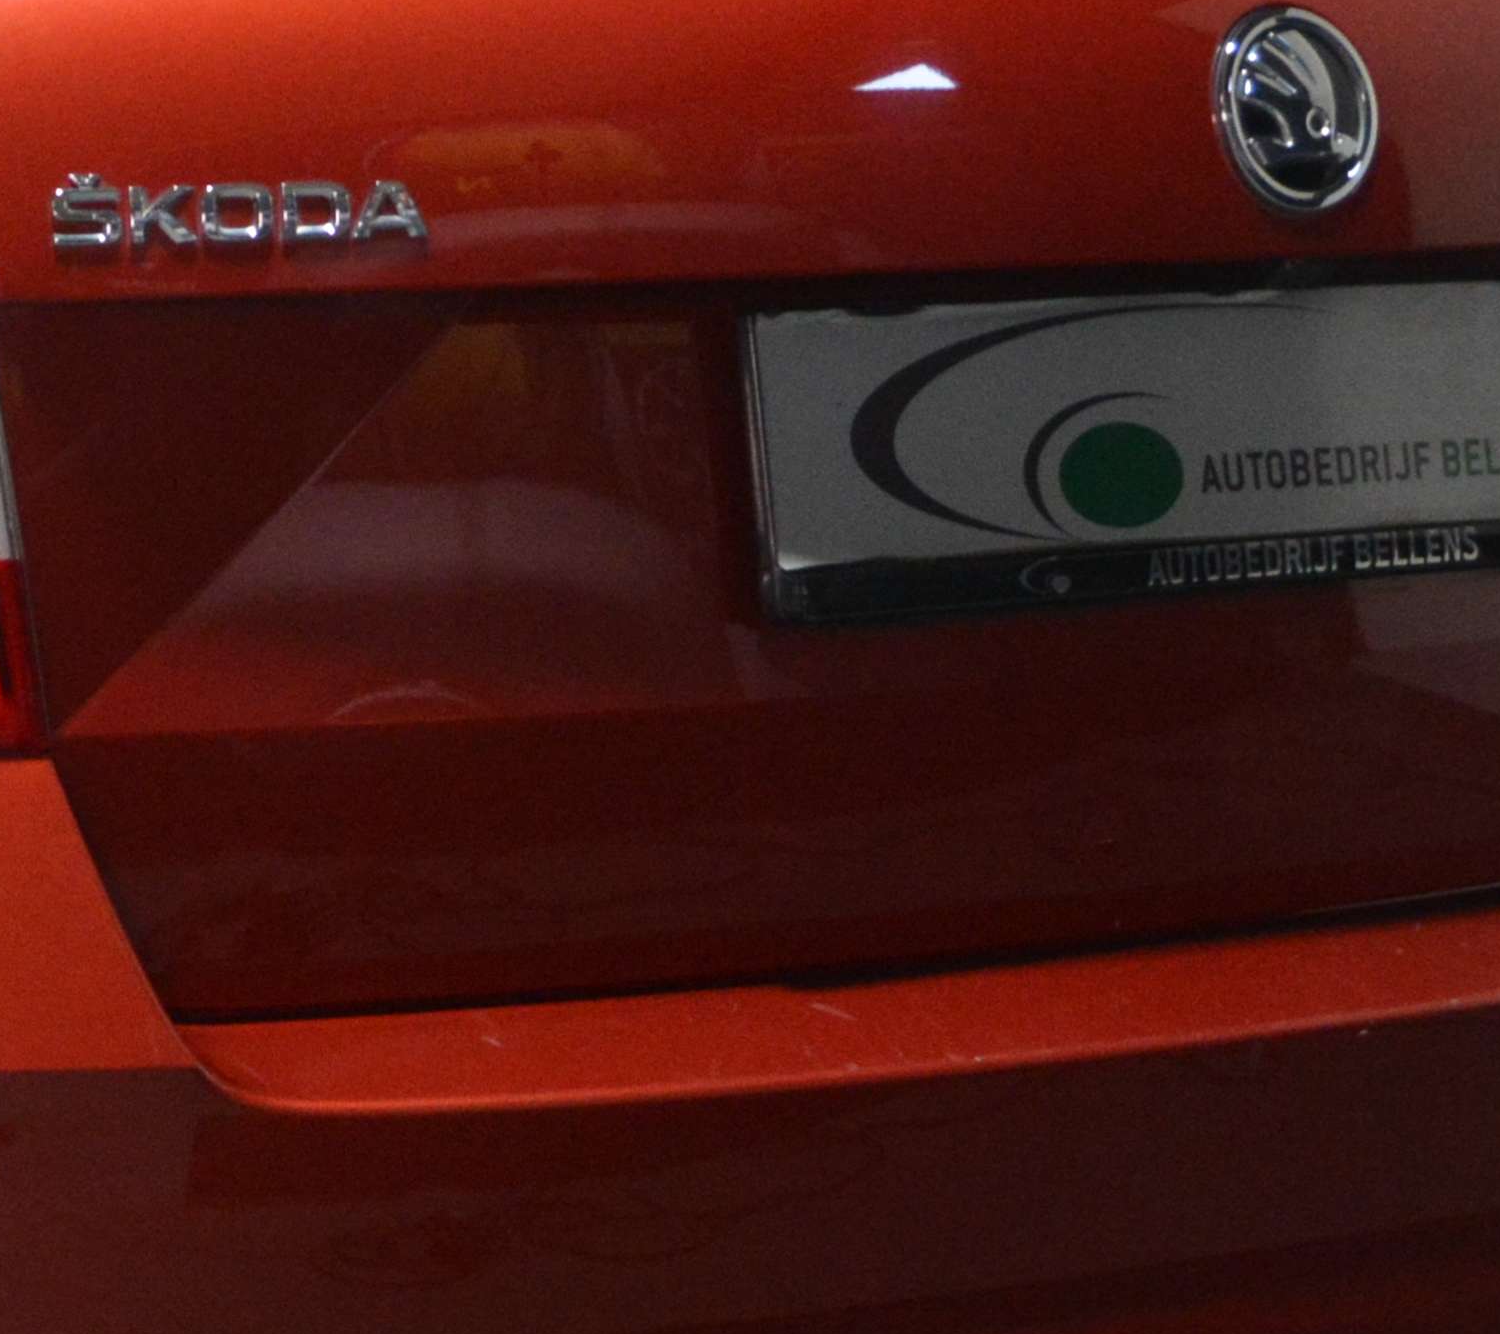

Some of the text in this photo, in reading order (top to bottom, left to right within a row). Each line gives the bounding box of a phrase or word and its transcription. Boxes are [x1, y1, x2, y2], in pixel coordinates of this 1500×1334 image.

[53, 172, 427, 244] ŠKODA
[1200, 442, 1430, 495] AUTOBEDRIJF
[1147, 525, 1479, 587] AUTOBEDRIJF BELLENS
